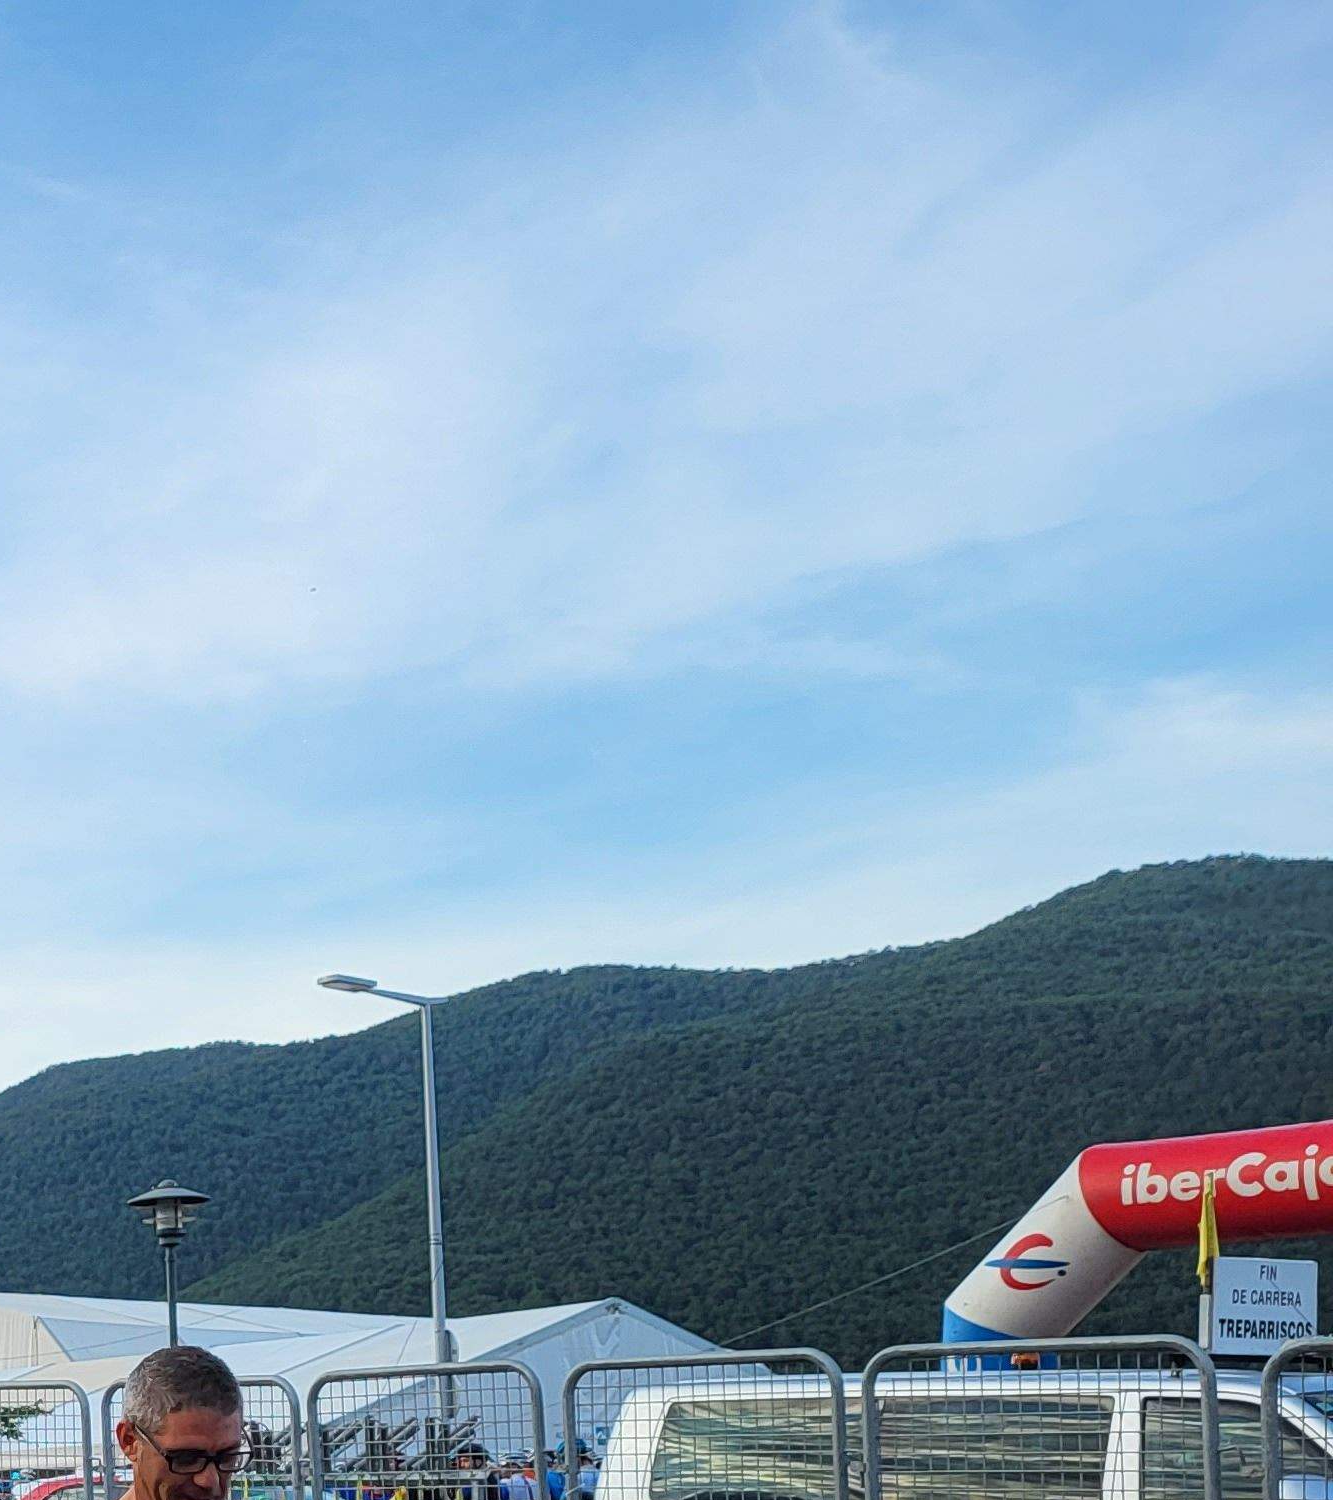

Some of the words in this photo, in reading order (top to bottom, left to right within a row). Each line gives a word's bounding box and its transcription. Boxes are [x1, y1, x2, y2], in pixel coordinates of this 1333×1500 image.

[1259, 1264, 1278, 1282] FIN
[1231, 1289, 1249, 1306] DE
[1250, 1290, 1302, 1307] CARRERA
[1218, 1318, 1313, 1340] TREPARRISCOS
